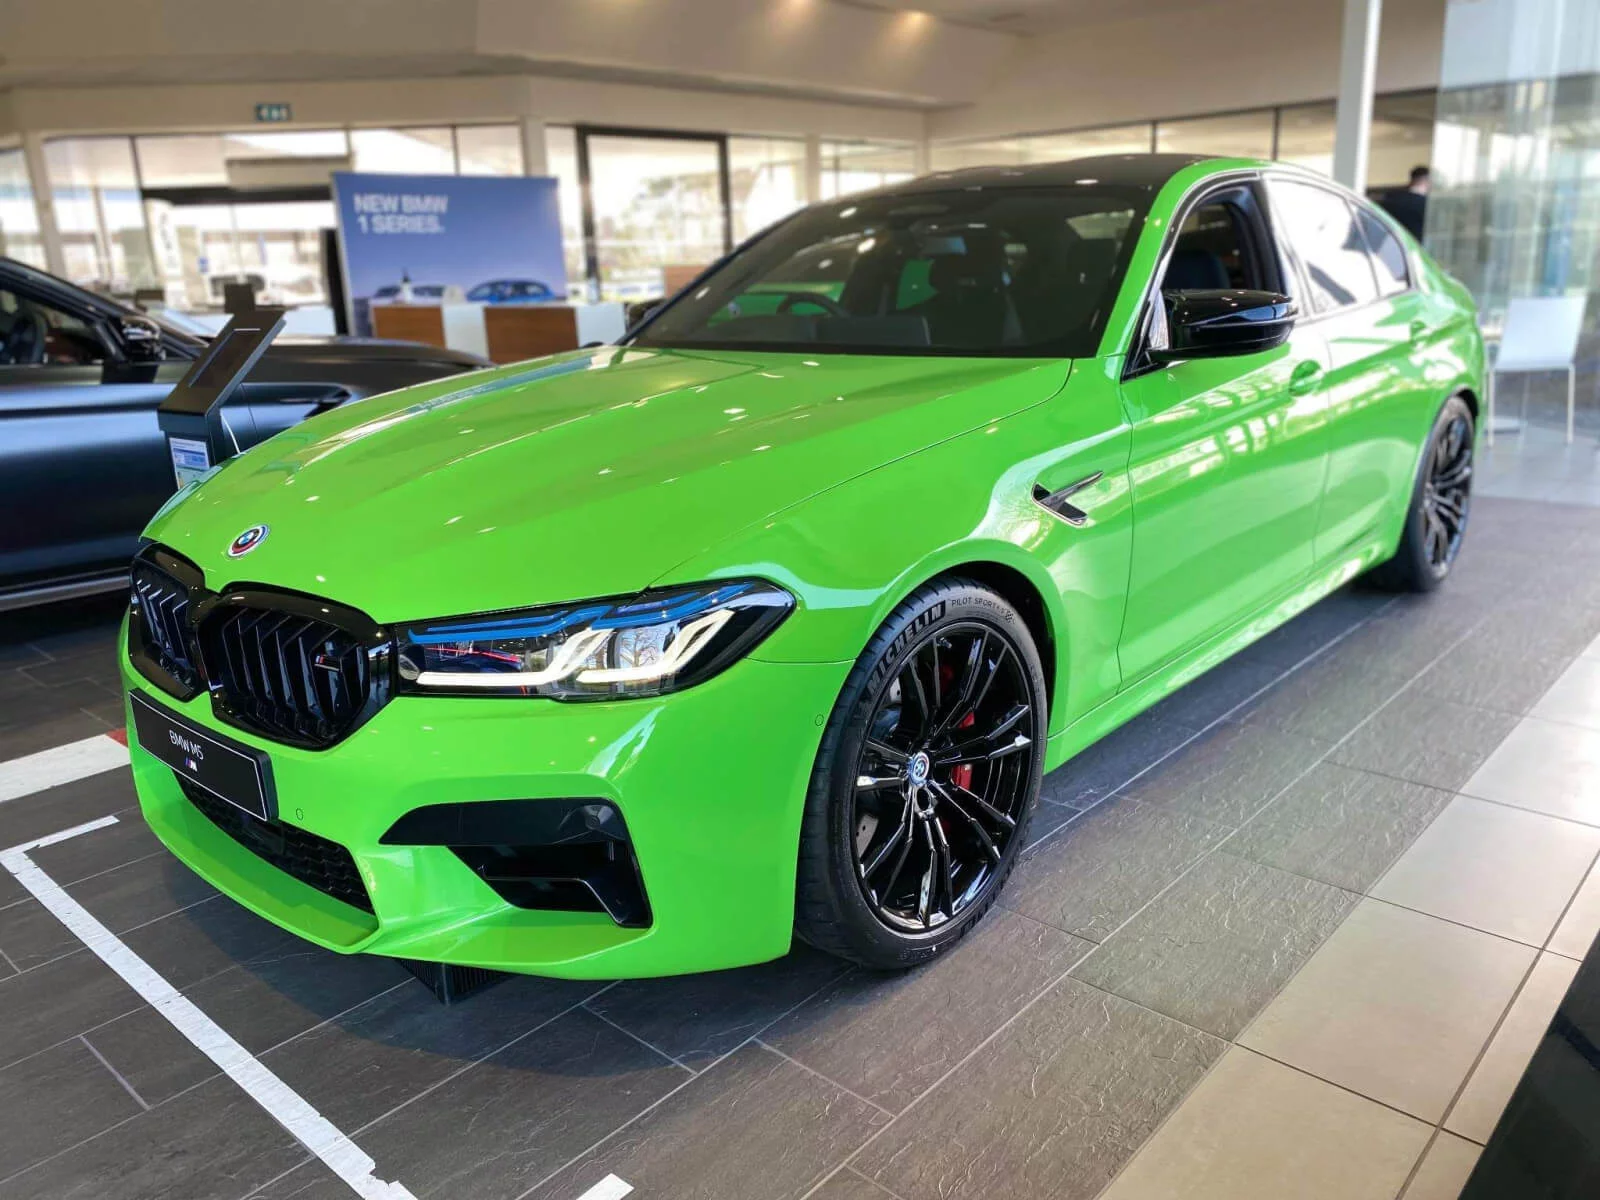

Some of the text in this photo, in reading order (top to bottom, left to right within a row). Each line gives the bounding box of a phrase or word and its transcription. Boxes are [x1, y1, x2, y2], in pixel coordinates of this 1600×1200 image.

[353, 193, 449, 214] NEW BMW
[357, 213, 445, 234] 1 SERIES.
[951, 597, 972, 607] PILOT
[867, 604, 943, 695] MICHELIN
[169, 730, 204, 760] BMW M5
